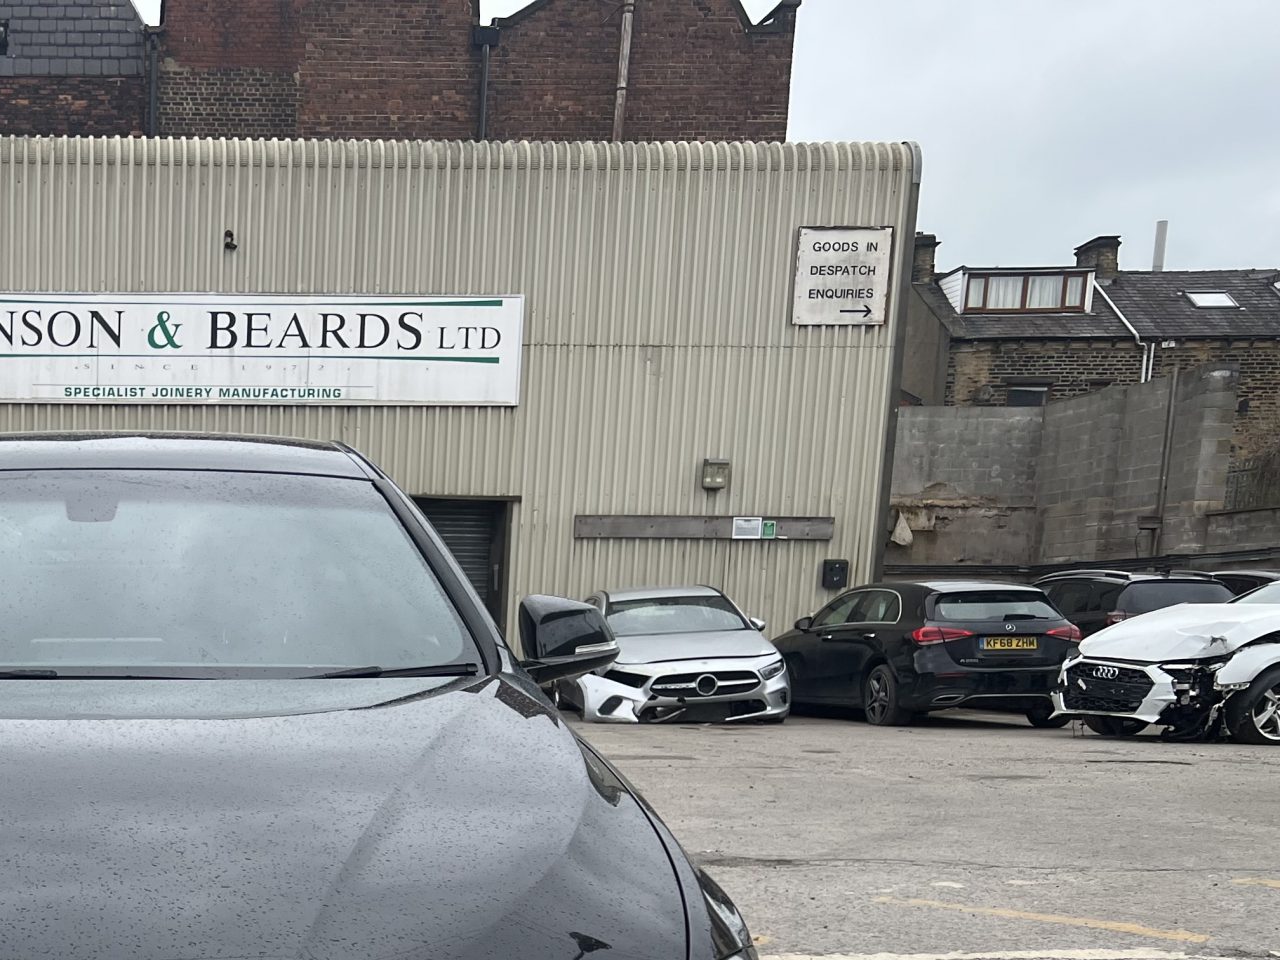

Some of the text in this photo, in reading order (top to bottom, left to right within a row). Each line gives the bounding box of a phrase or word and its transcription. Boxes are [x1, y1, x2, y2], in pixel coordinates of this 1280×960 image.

[812, 241, 878, 252] GOODS IN
[810, 265, 876, 276] DESPATCH
[808, 288, 874, 299] ENQUIRIES
[147, 310, 184, 349] &
[206, 311, 424, 350] BEARDS
[437, 326, 502, 350] LTD
[64, 386, 342, 399] SPECIALIST JOINERY MANUFACTURING
[985, 638, 1013, 648] KF68
